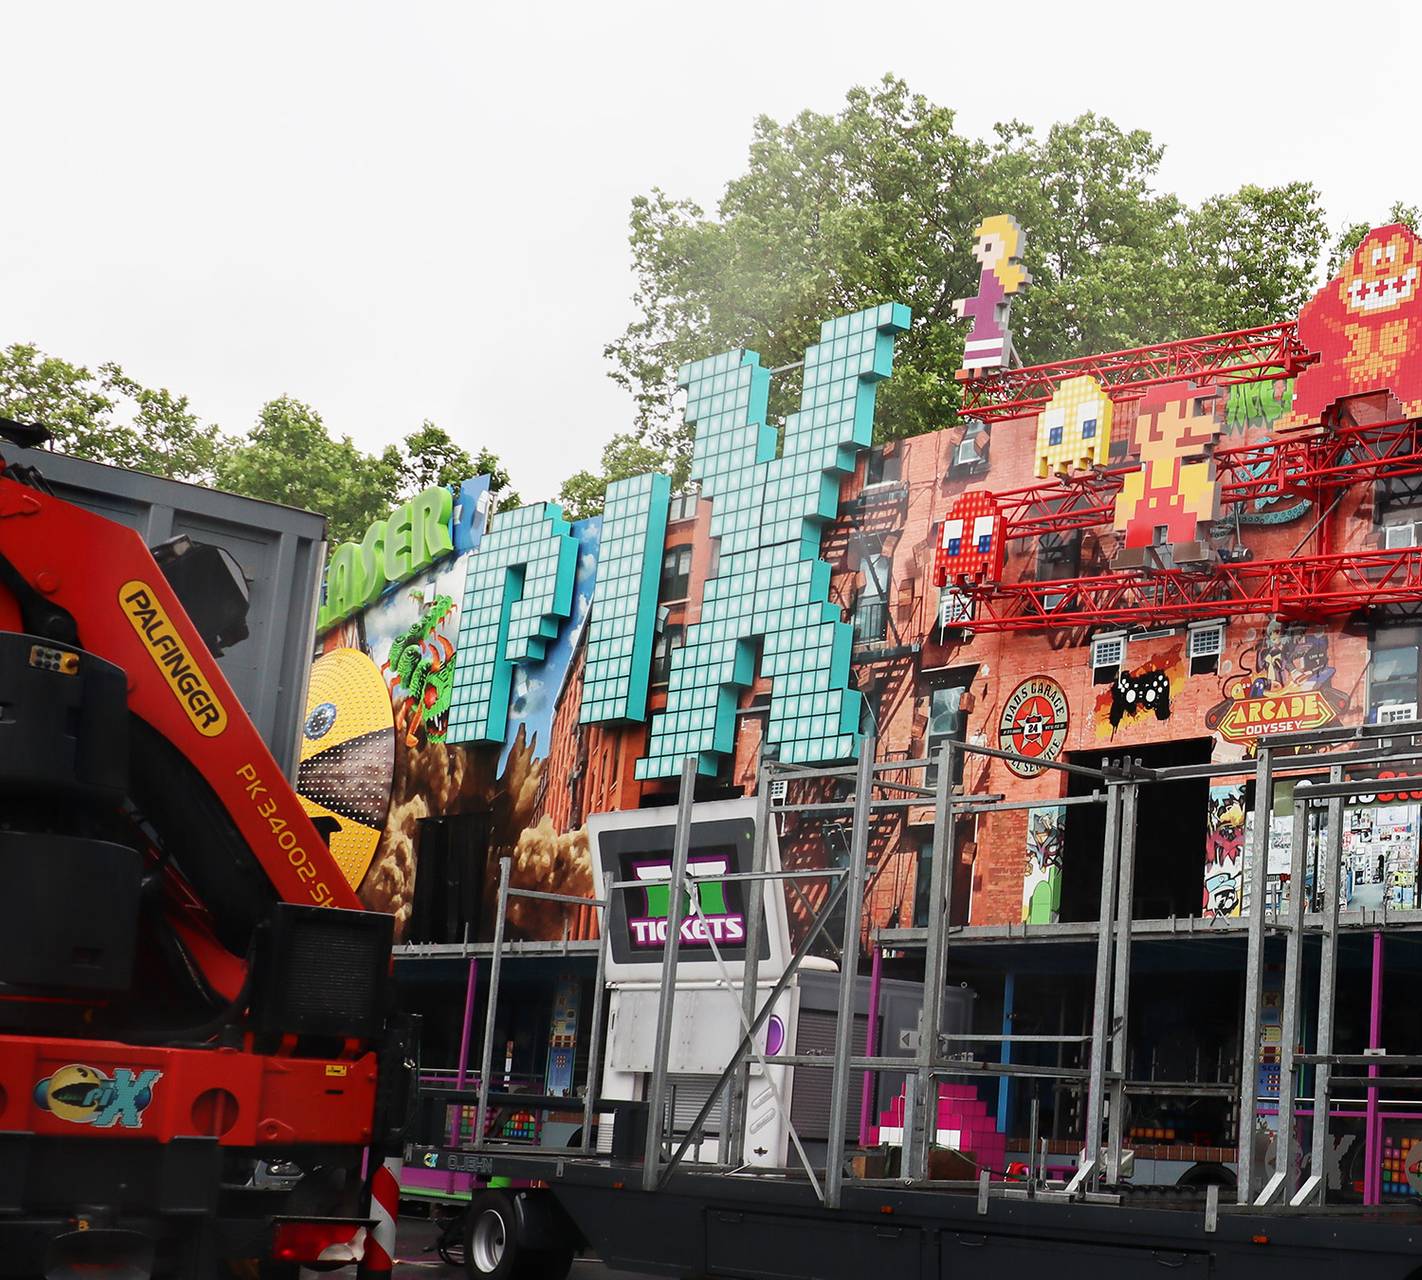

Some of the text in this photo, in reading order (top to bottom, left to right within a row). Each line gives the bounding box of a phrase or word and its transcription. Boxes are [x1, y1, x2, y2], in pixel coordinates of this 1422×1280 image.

[317, 486, 454, 632] ASER
[446, 302, 911, 781] PIX
[125, 589, 220, 729] PALFINGER
[1030, 682, 1065, 717] GARAGE
[1234, 695, 1320, 724] ARCADE
[1028, 724, 1038, 733] 24
[1246, 720, 1304, 735] ODYSSEY
[236, 763, 267, 800] PK
